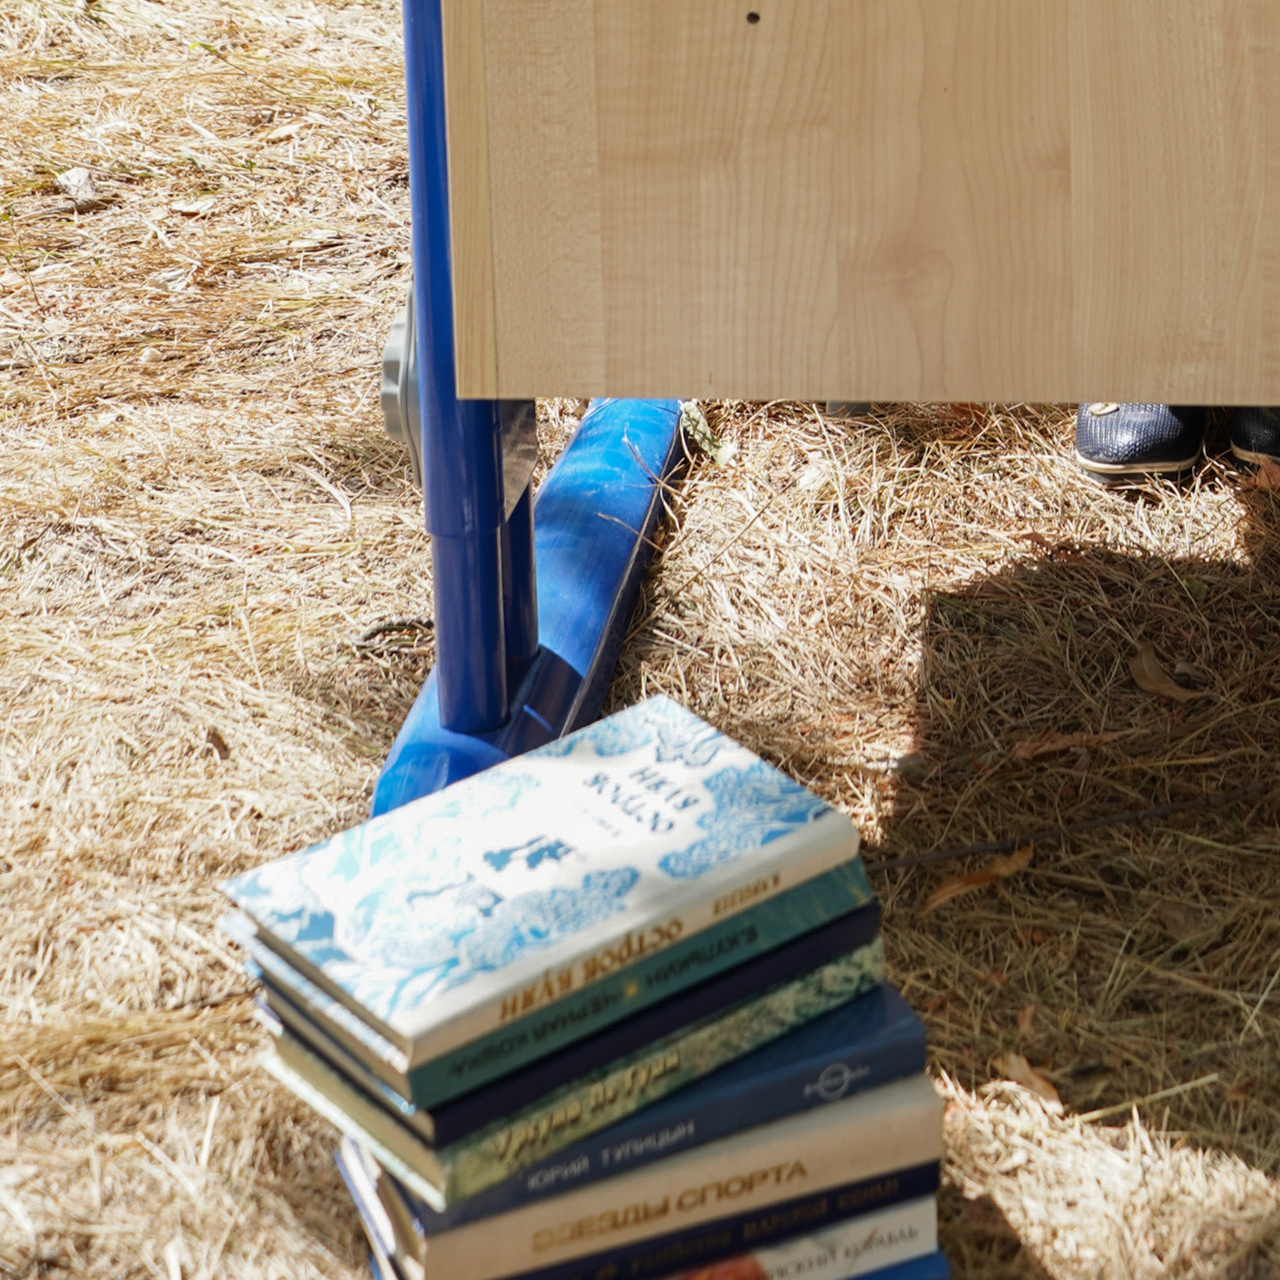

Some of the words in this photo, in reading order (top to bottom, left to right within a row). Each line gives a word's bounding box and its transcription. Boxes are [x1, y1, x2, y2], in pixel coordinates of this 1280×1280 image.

[583, 918, 683, 983] ОСТРОВ
[499, 967, 573, 1021] БУЯН
[526, 1154, 590, 1191] ЮРИЙ
[675, 1159, 809, 1213] СПОРТА
